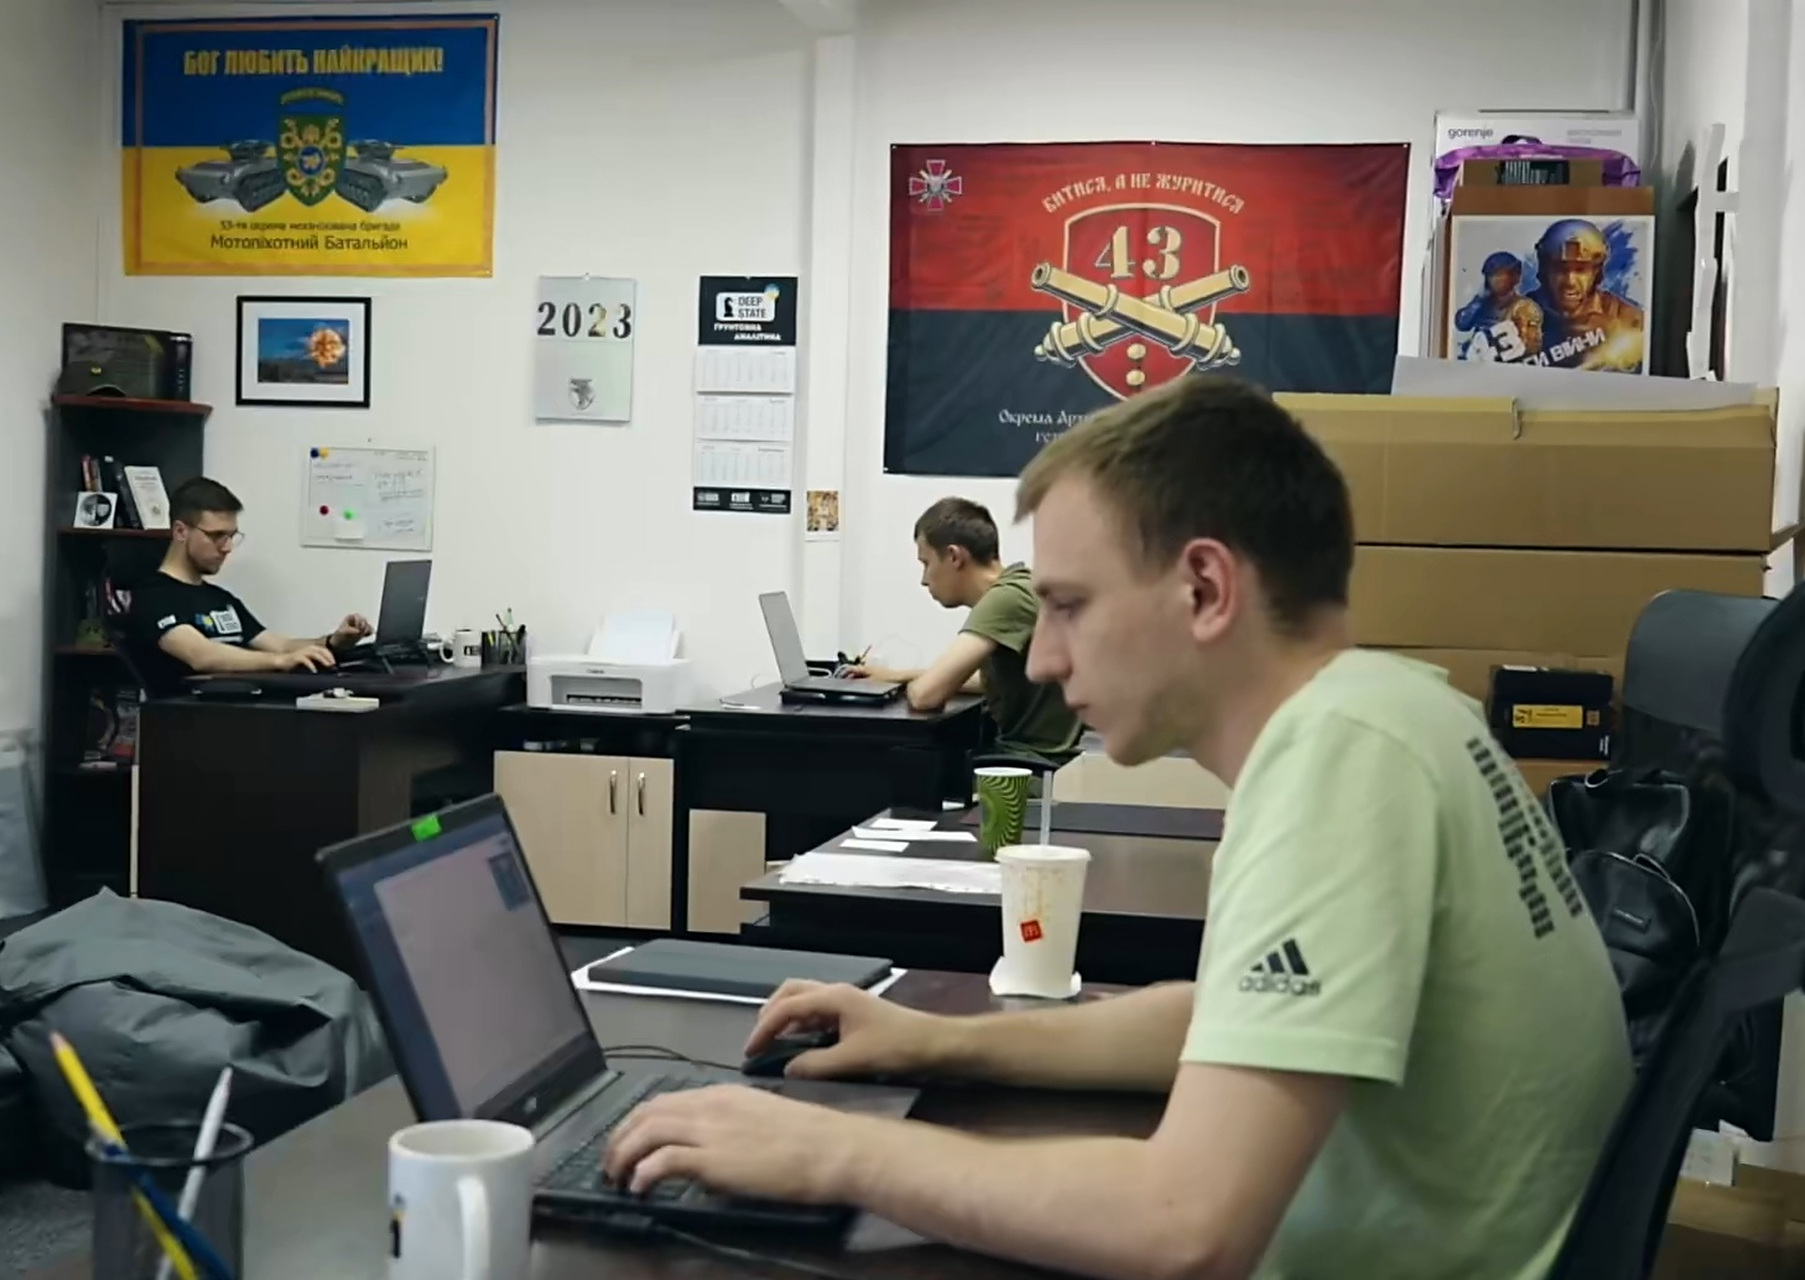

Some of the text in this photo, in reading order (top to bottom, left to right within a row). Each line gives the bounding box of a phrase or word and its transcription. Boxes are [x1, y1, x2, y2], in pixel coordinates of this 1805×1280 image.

[184, 50, 220, 75] БОГ
[224, 49, 308, 75] ЛЮБИТЬ
[1447, 127, 1494, 140] gorenje
[1115, 174, 1125, 190] А
[1130, 172, 1151, 189] НЕ
[1156, 173, 1246, 215] ЖУРИТИСЯ
[210, 234, 408, 250] Мотопіхотний Батальйон
[1093, 225, 1183, 281] 43
[738, 296, 763, 306] DEEP
[537, 301, 632, 339] 2023
[738, 307, 767, 319] STATE
[1550, 327, 1606, 362] ВІЙНИ
[998, 408, 1053, 427] Окрема
[1238, 975, 1322, 997] adidas
